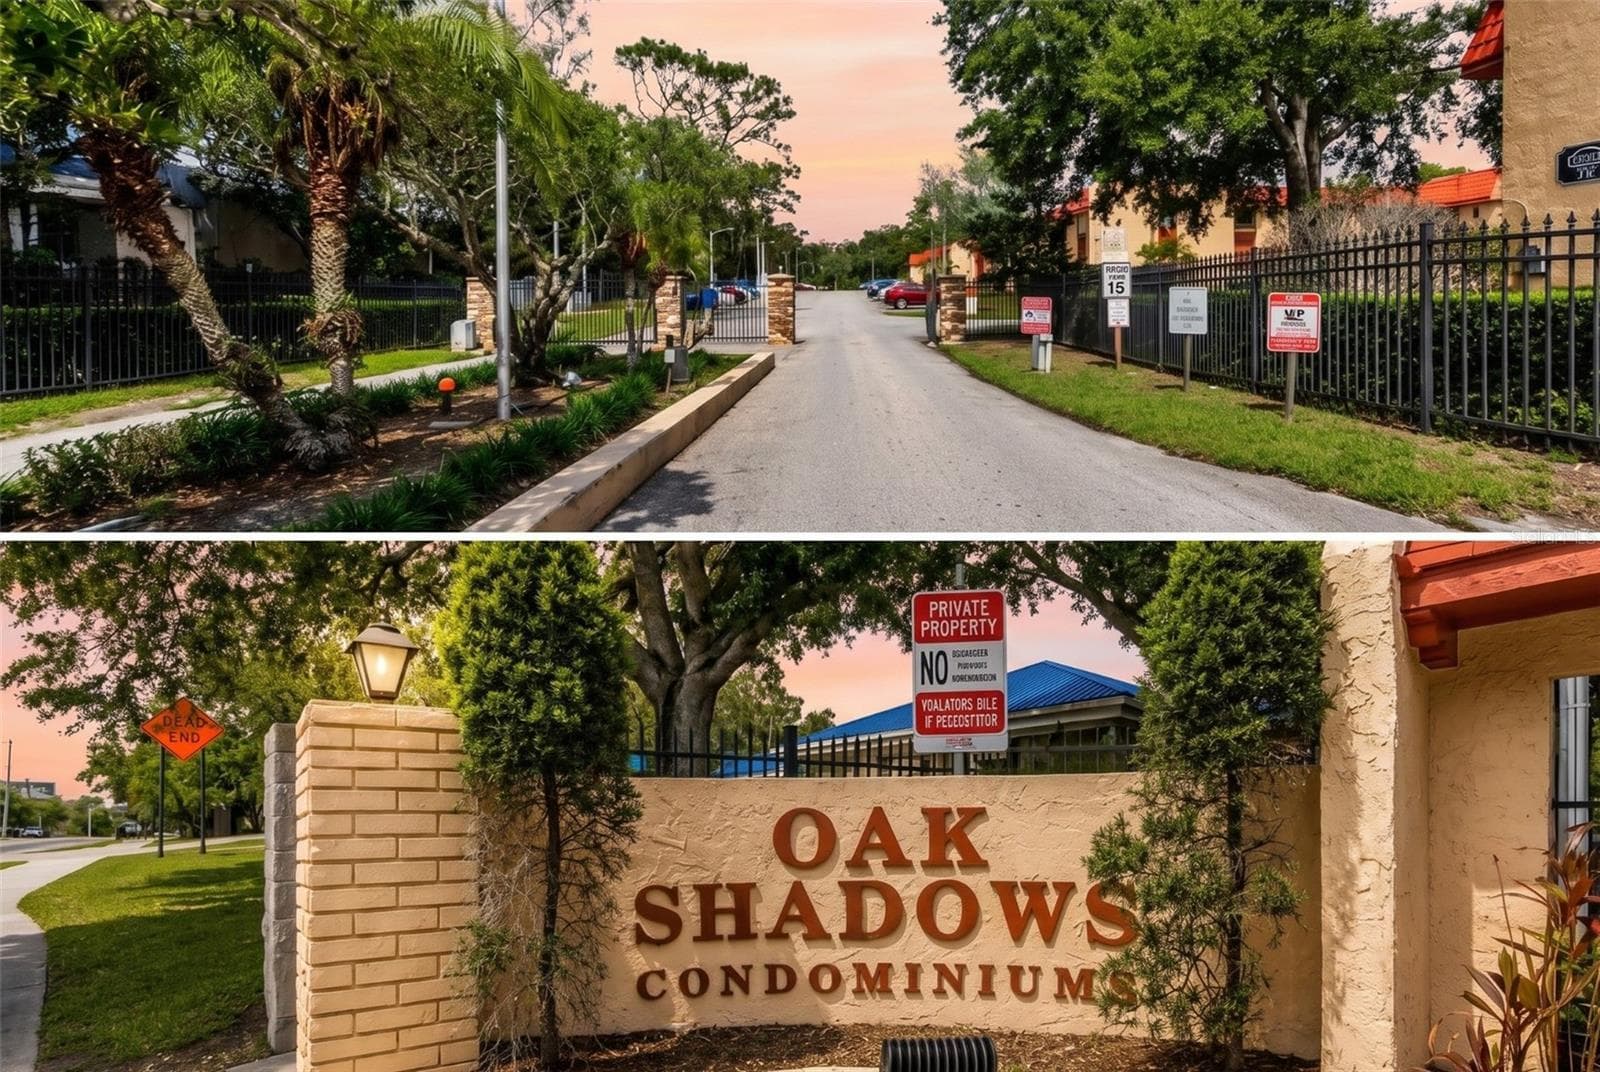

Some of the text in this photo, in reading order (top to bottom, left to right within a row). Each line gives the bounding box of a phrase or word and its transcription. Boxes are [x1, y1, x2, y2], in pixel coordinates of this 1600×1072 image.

[1107, 281, 1125, 294] 15
[929, 600, 989, 618] PRIVATE
[921, 618, 997, 638] PROPERTY
[920, 650, 948, 685] NO
[976, 697, 998, 710] BILE
[163, 715, 208, 729] DEAD
[924, 715, 934, 728] IF
[169, 731, 200, 743] END
[772, 806, 989, 869] OAK
[634, 879, 1138, 946] SHADOWS
